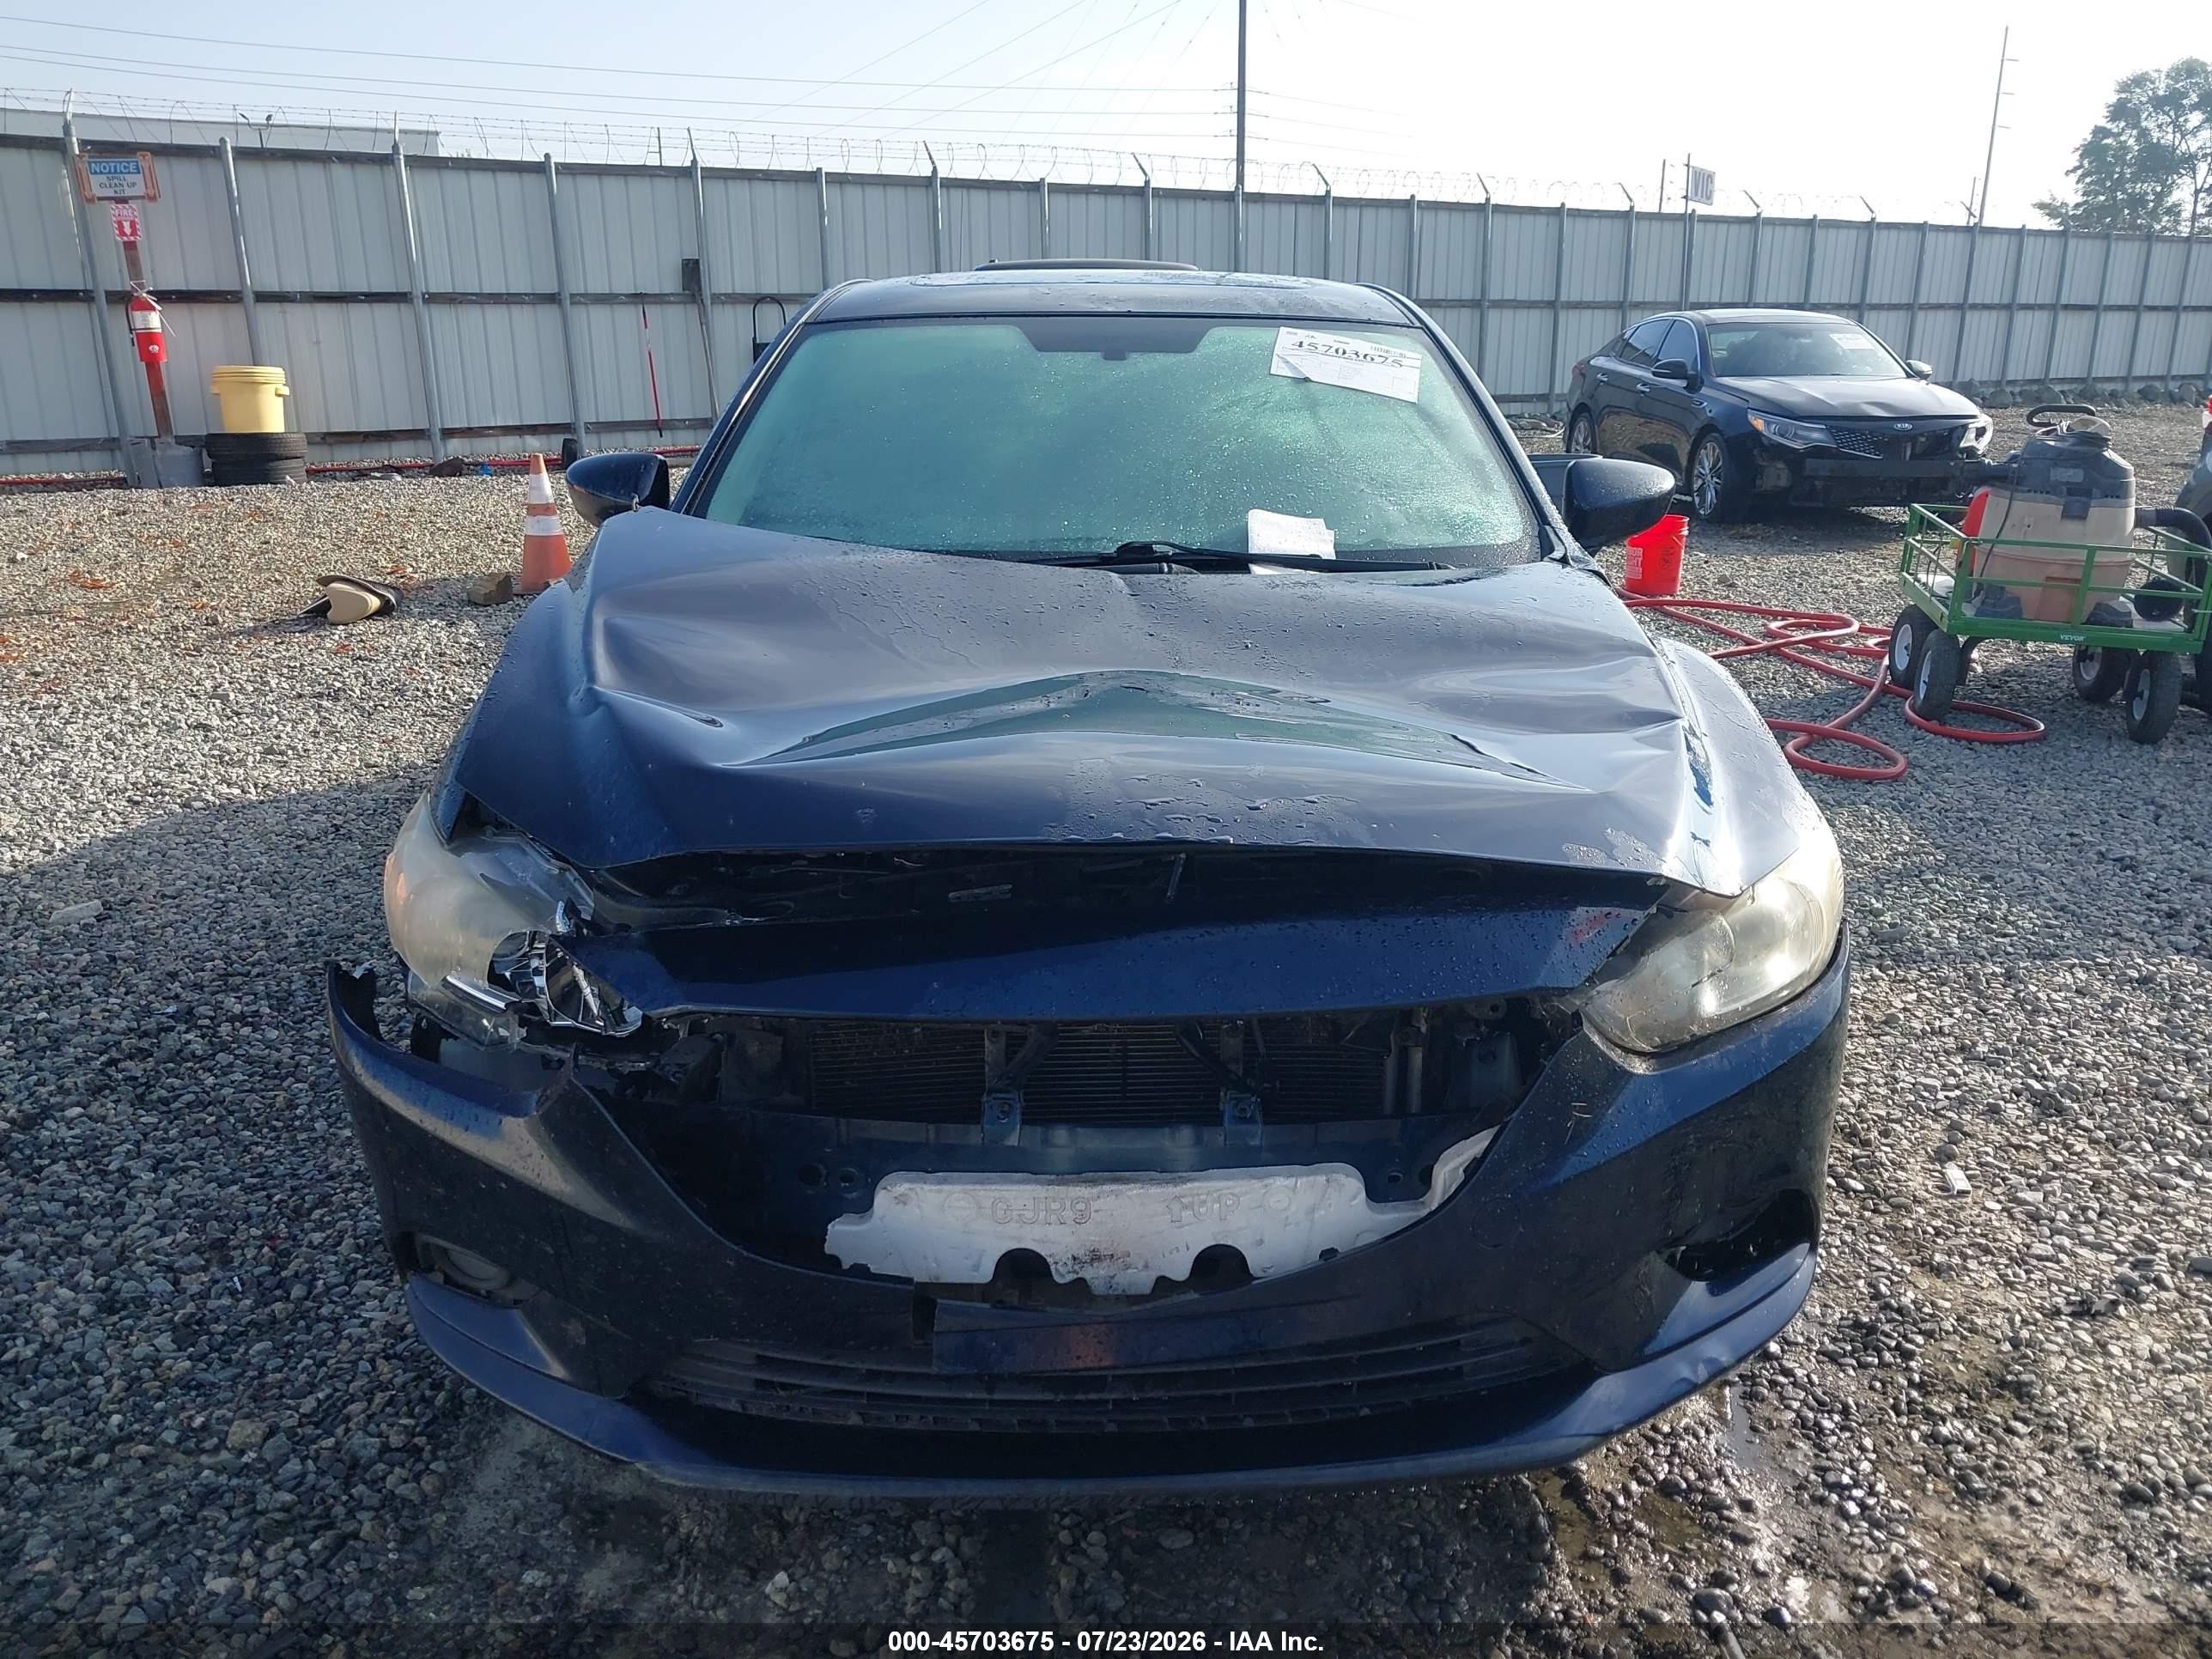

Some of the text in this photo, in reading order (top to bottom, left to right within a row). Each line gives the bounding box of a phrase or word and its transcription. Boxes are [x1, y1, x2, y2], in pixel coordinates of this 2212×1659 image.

[90, 161, 138, 173] NOTICE
[1291, 340, 1404, 369] 45703675
[1193, 1191, 1241, 1221] UP
